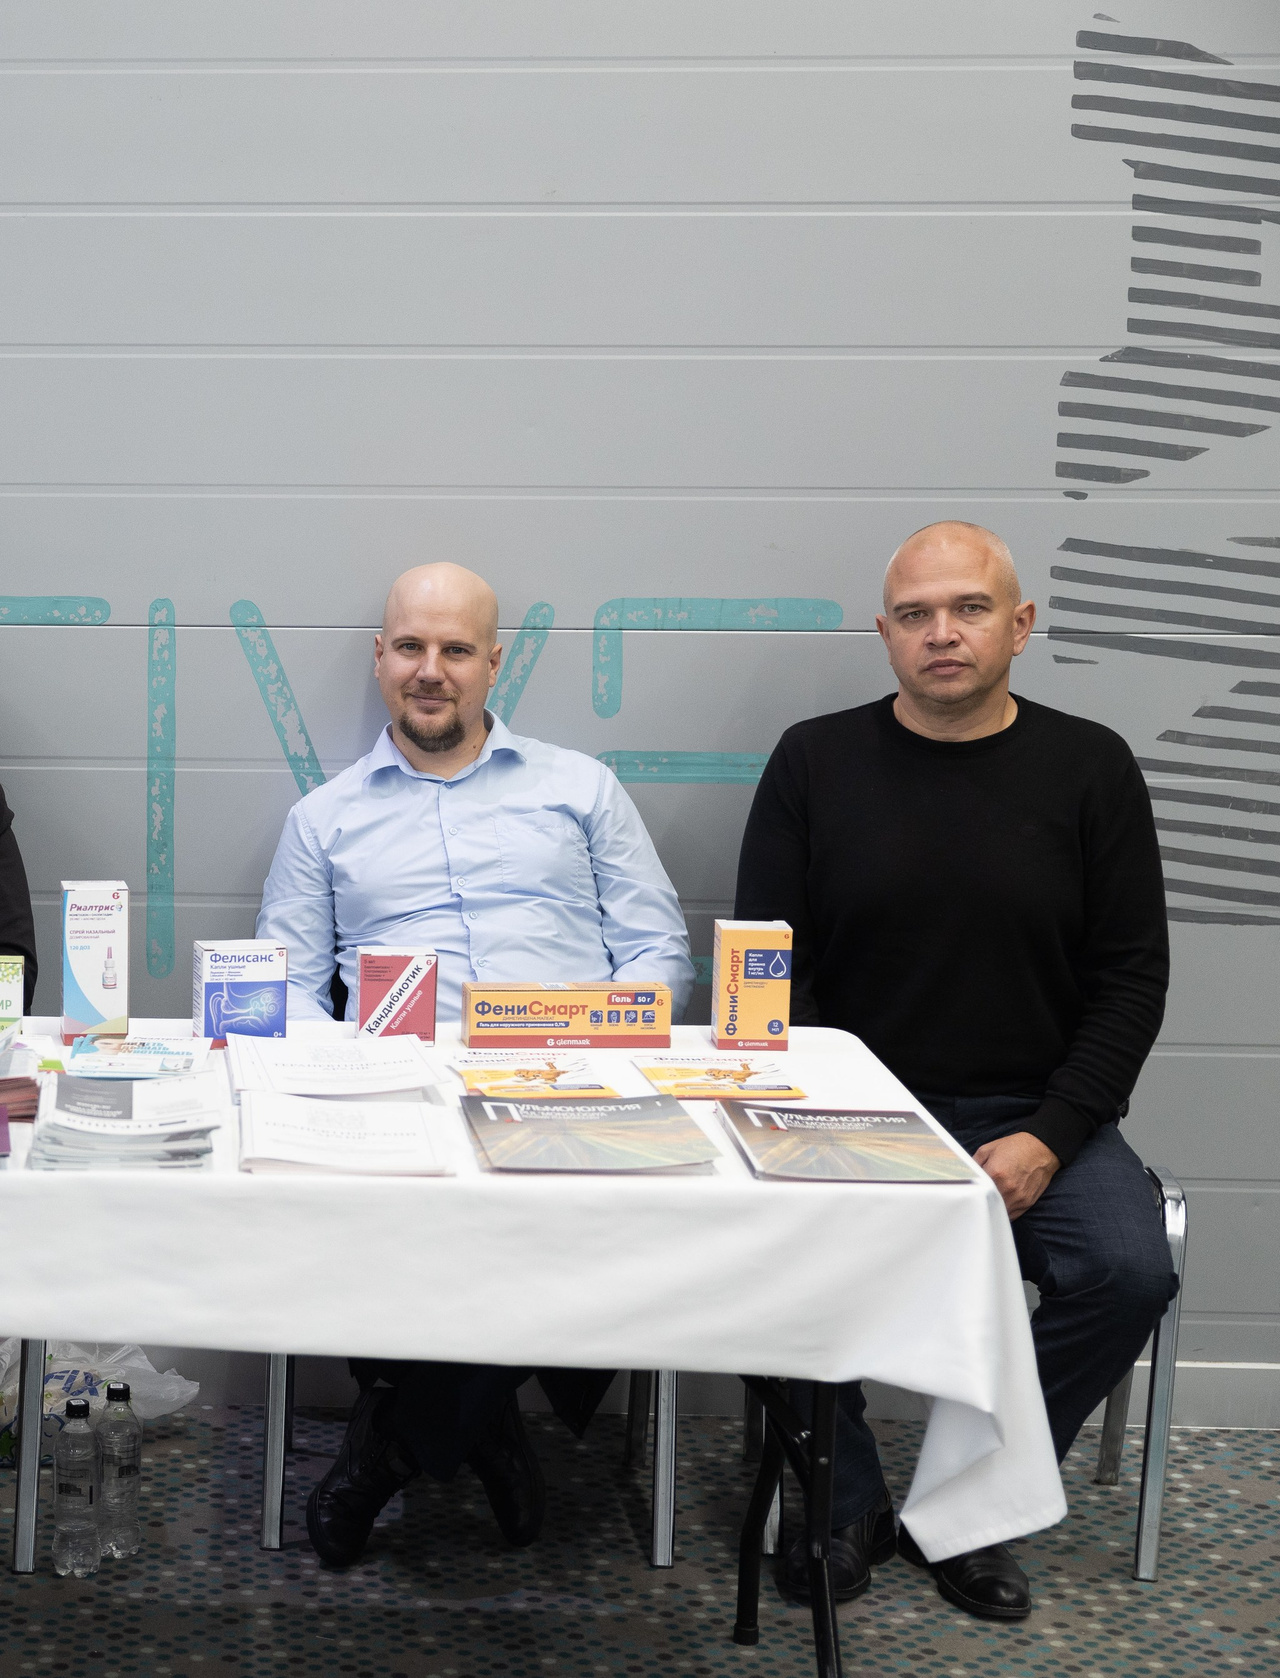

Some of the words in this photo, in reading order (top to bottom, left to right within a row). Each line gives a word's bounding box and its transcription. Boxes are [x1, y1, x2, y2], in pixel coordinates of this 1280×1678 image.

[69, 903, 115, 912] Риалтрис
[209, 953, 274, 963] Фелисанс
[365, 964, 423, 1035] Кандибиотик
[611, 995, 632, 1003] Гель
[725, 948, 743, 1036] ФениСмарт
[474, 1000, 589, 1019] ФениСмарт
[481, 1101, 642, 1122] ПУЛЬМОНОЛОГИЯ
[744, 1108, 907, 1131] ПУЛЬМОНОЛОГИЯ
